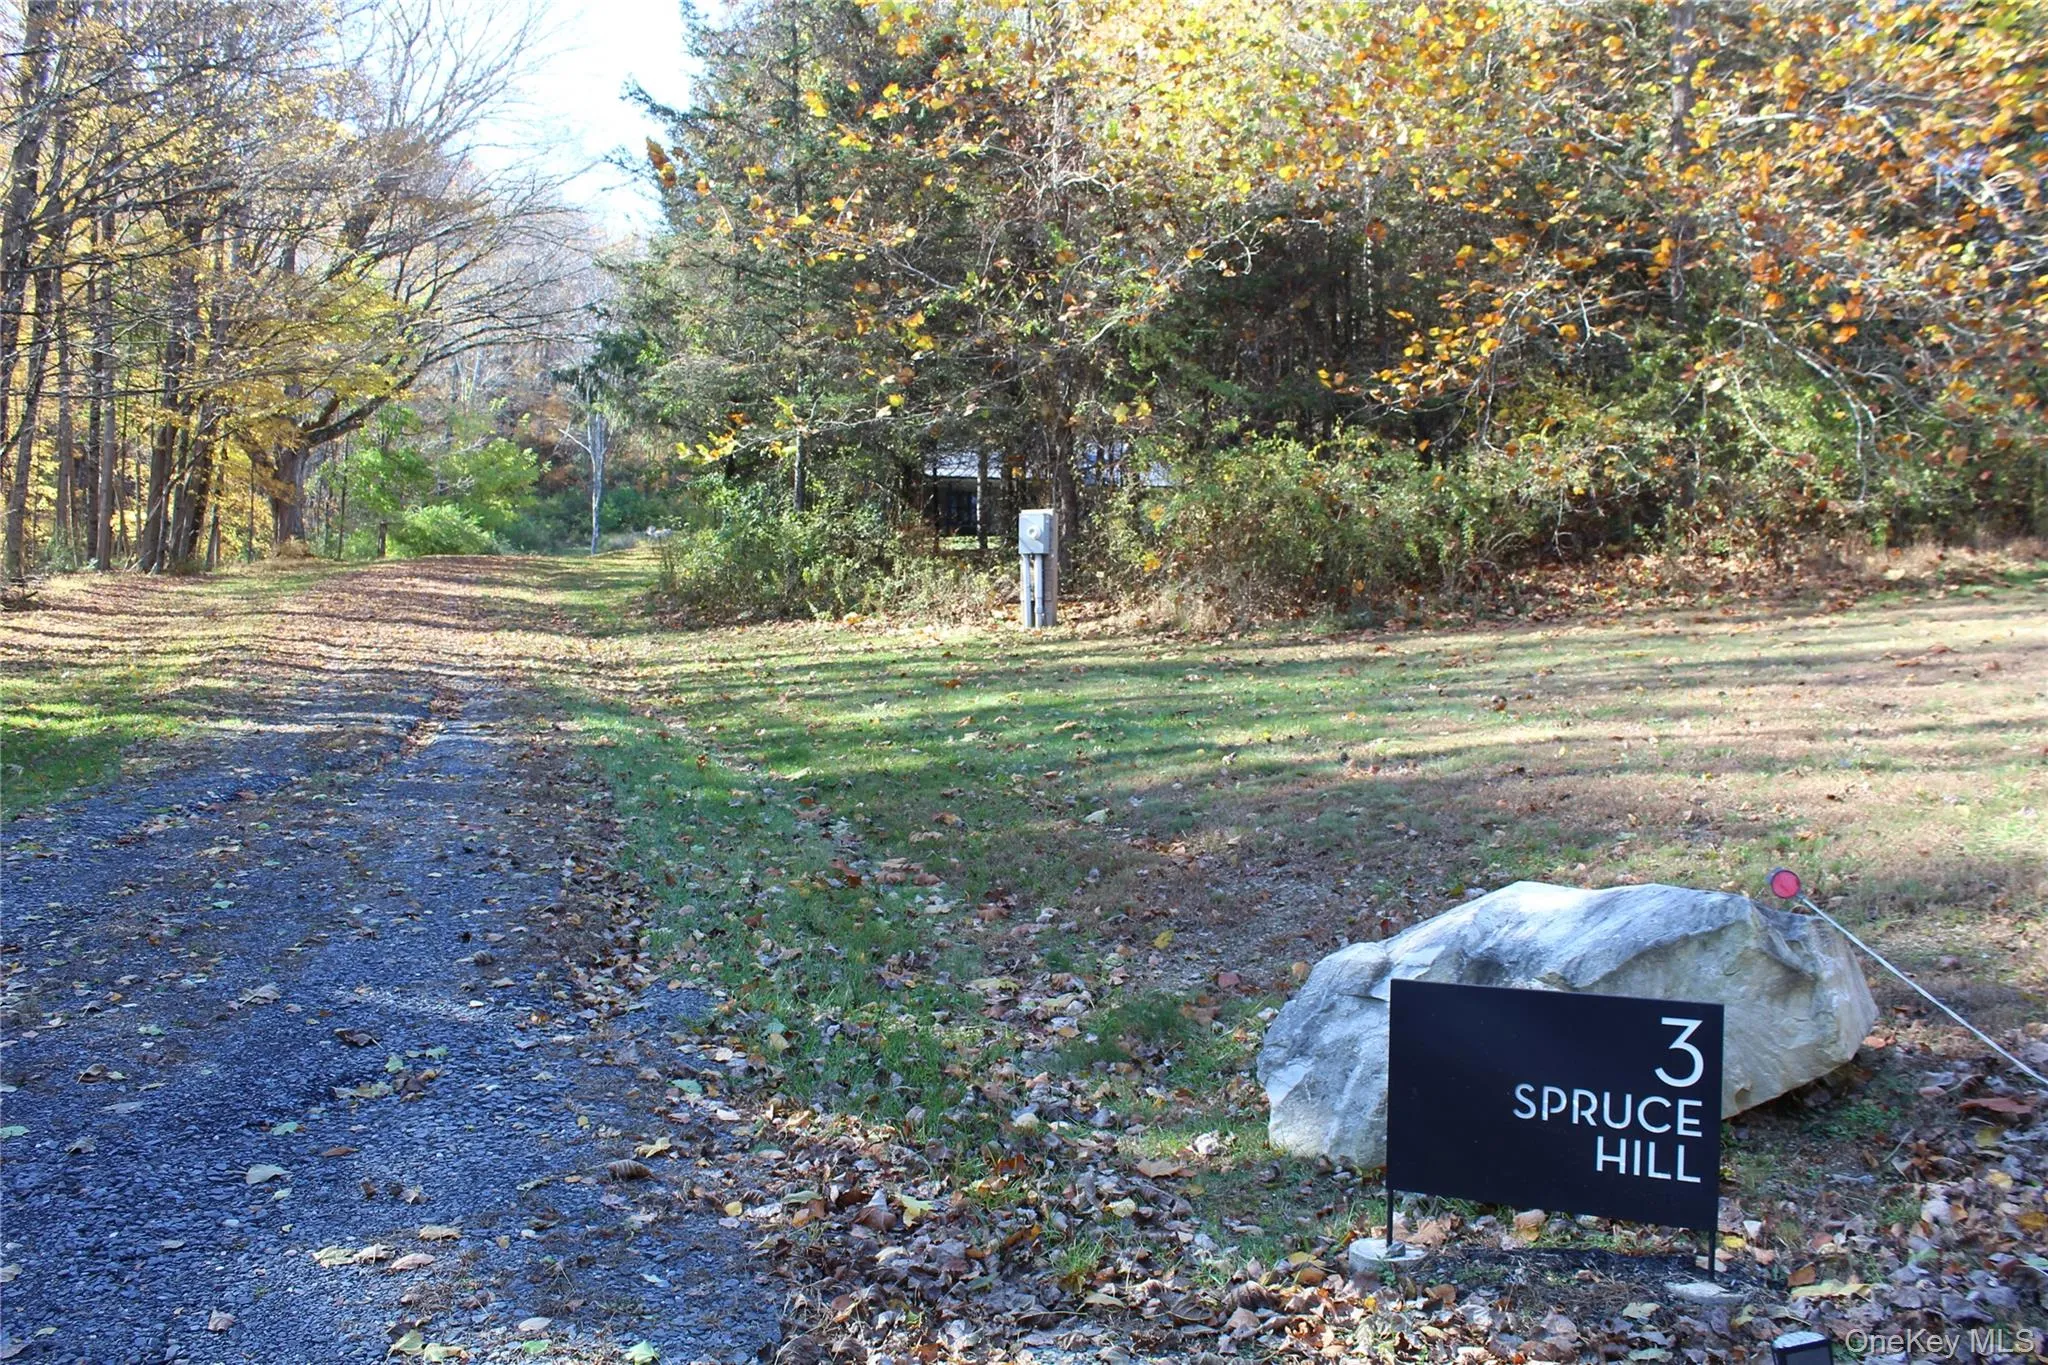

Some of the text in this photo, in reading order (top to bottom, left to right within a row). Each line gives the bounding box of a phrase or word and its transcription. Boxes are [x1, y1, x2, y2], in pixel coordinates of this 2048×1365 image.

[1655, 1017, 1704, 1087] 3
[1513, 1083, 1703, 1137] SPRUCE
[1596, 1136, 1701, 1183] HILL
